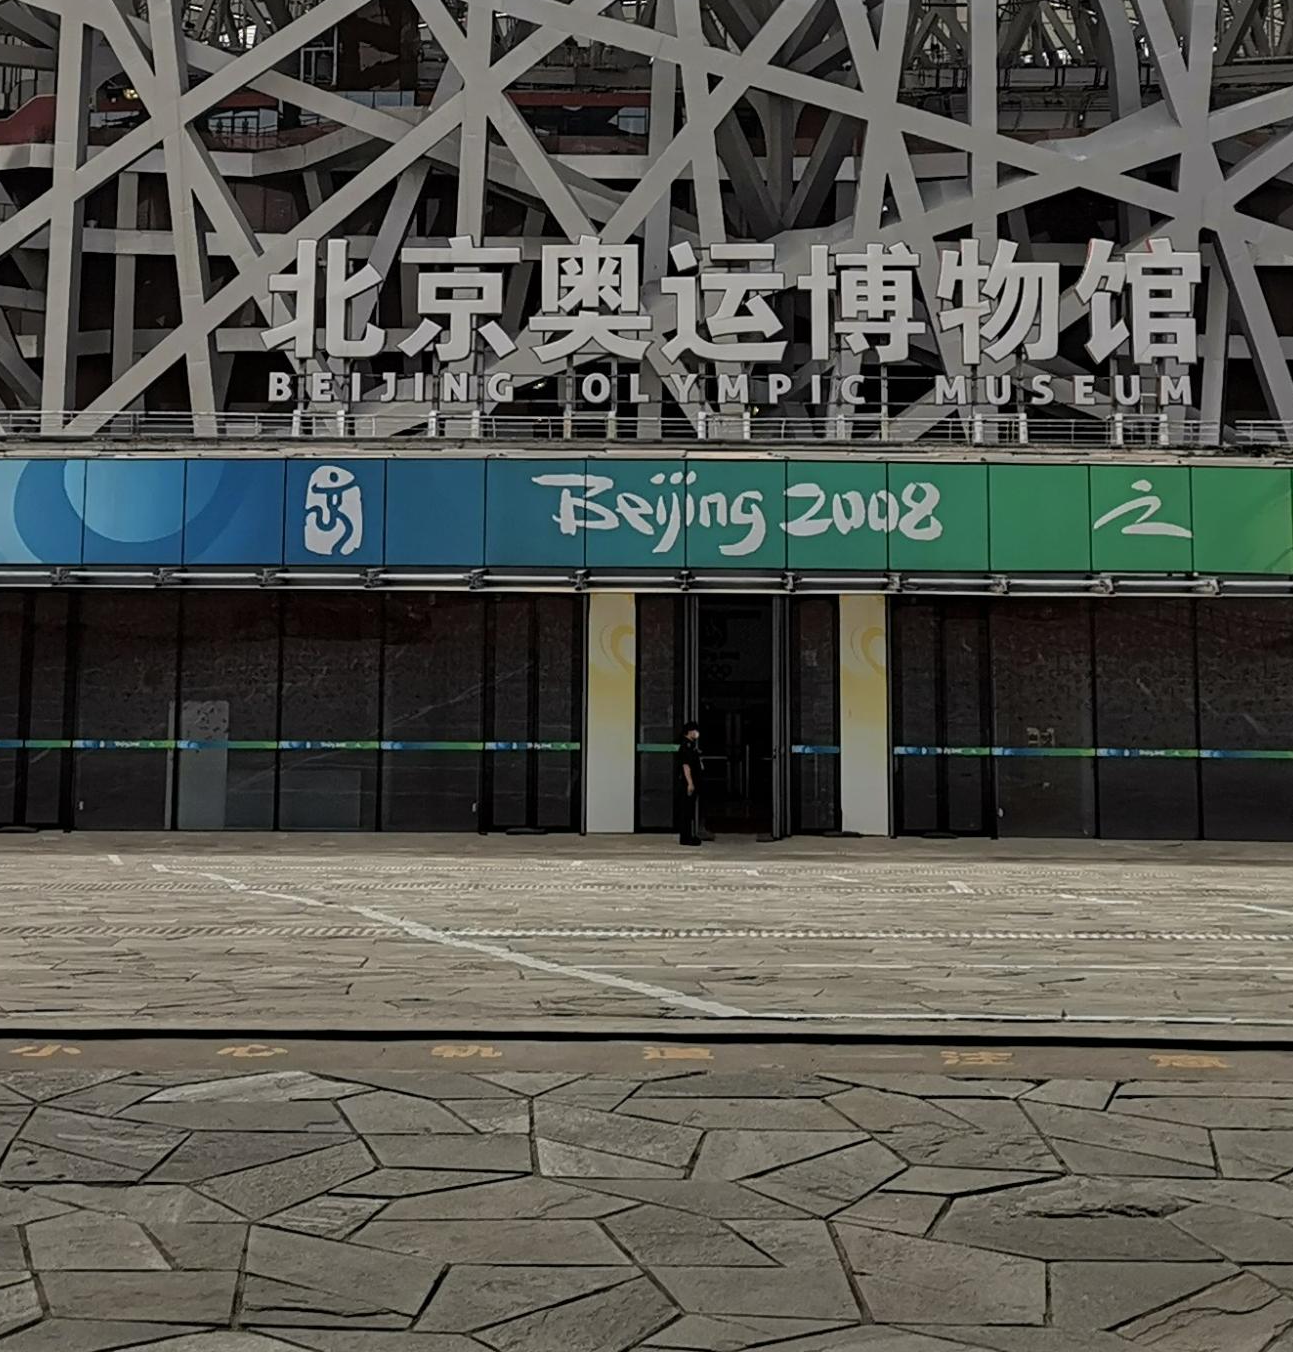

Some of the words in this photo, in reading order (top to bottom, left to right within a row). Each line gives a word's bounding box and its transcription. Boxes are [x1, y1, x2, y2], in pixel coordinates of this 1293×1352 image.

[260, 234, 1201, 365] 北京奥运博物馆
[268, 371, 514, 402] BEIJING
[581, 372, 866, 405] OLYMPIC
[934, 374, 1192, 405] MUSEUM
[531, 470, 767, 557] Beijing
[779, 481, 943, 541] 2008
